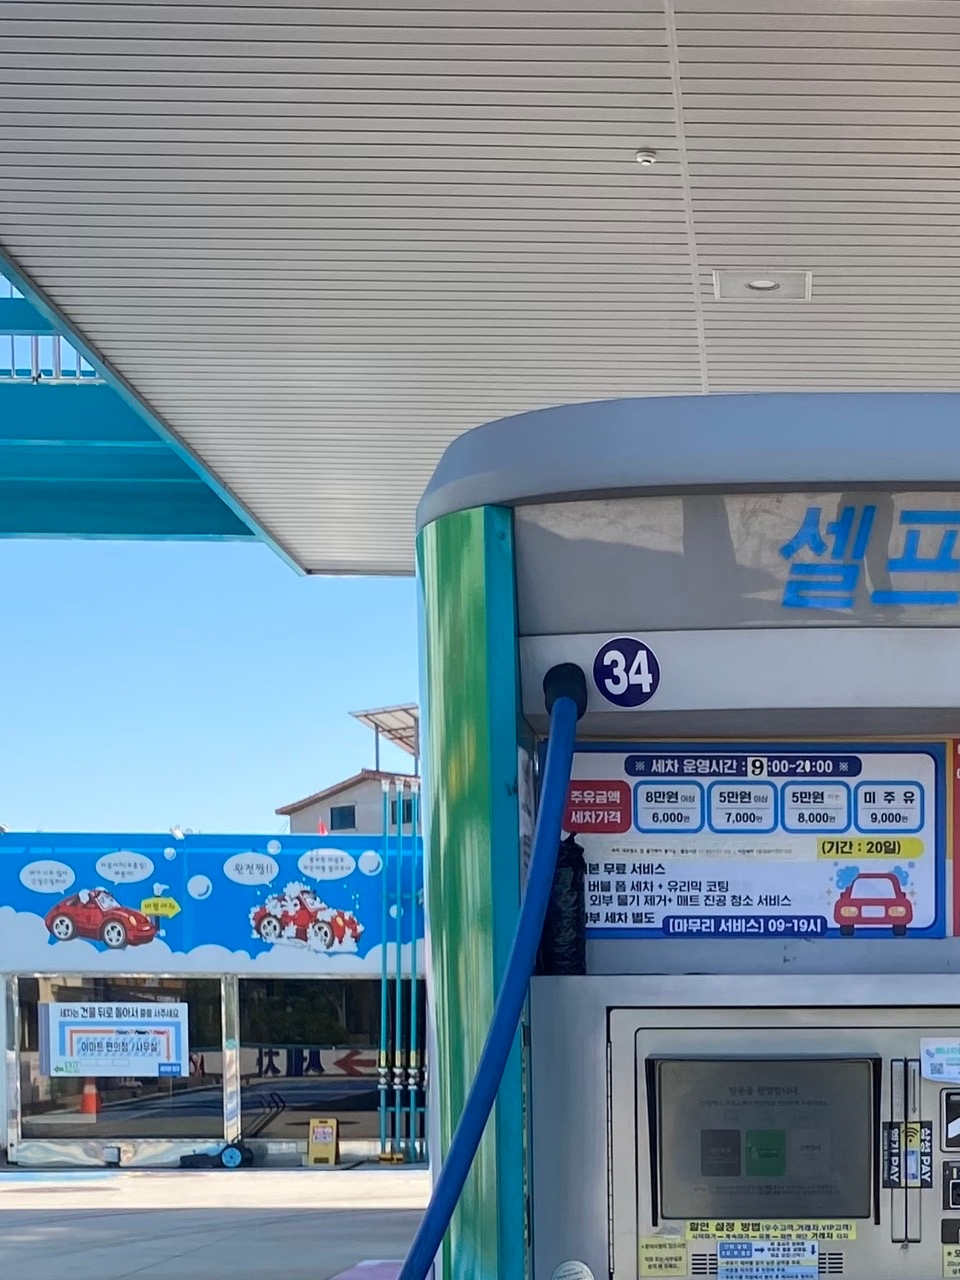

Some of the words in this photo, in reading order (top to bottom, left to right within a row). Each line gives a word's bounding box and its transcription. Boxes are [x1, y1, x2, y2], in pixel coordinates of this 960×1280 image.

[603, 650, 653, 695] 34
[651, 759, 679, 773] 세차
[682, 759, 737, 773] 운영시간
[571, 790, 621, 804] 주유금액
[645, 791, 678, 804] 8만원
[719, 791, 752, 804] 5만원
[792, 791, 824, 804] 5만원
[570, 811, 621, 824] 세차가격
[603, 863, 627, 875] 무료
[630, 863, 666, 875] 서비스
[630, 881, 654, 892] 세차
[667, 881, 702, 892] 유리막
[706, 881, 729, 893] 코팅
[589, 895, 613, 906] 외부
[617, 895, 640, 906] 물기
[676, 895, 700, 906] 매트
[703, 895, 726, 906] 진공
[730, 895, 753, 906] 청소
[757, 895, 792, 906] 서비스
[604, 912, 628, 924] 세차
[631, 912, 655, 924] 별도
[921, 1127, 931, 1153] 삼성
[890, 1156, 899, 1182] PAY
[921, 1156, 931, 1182] PAY
